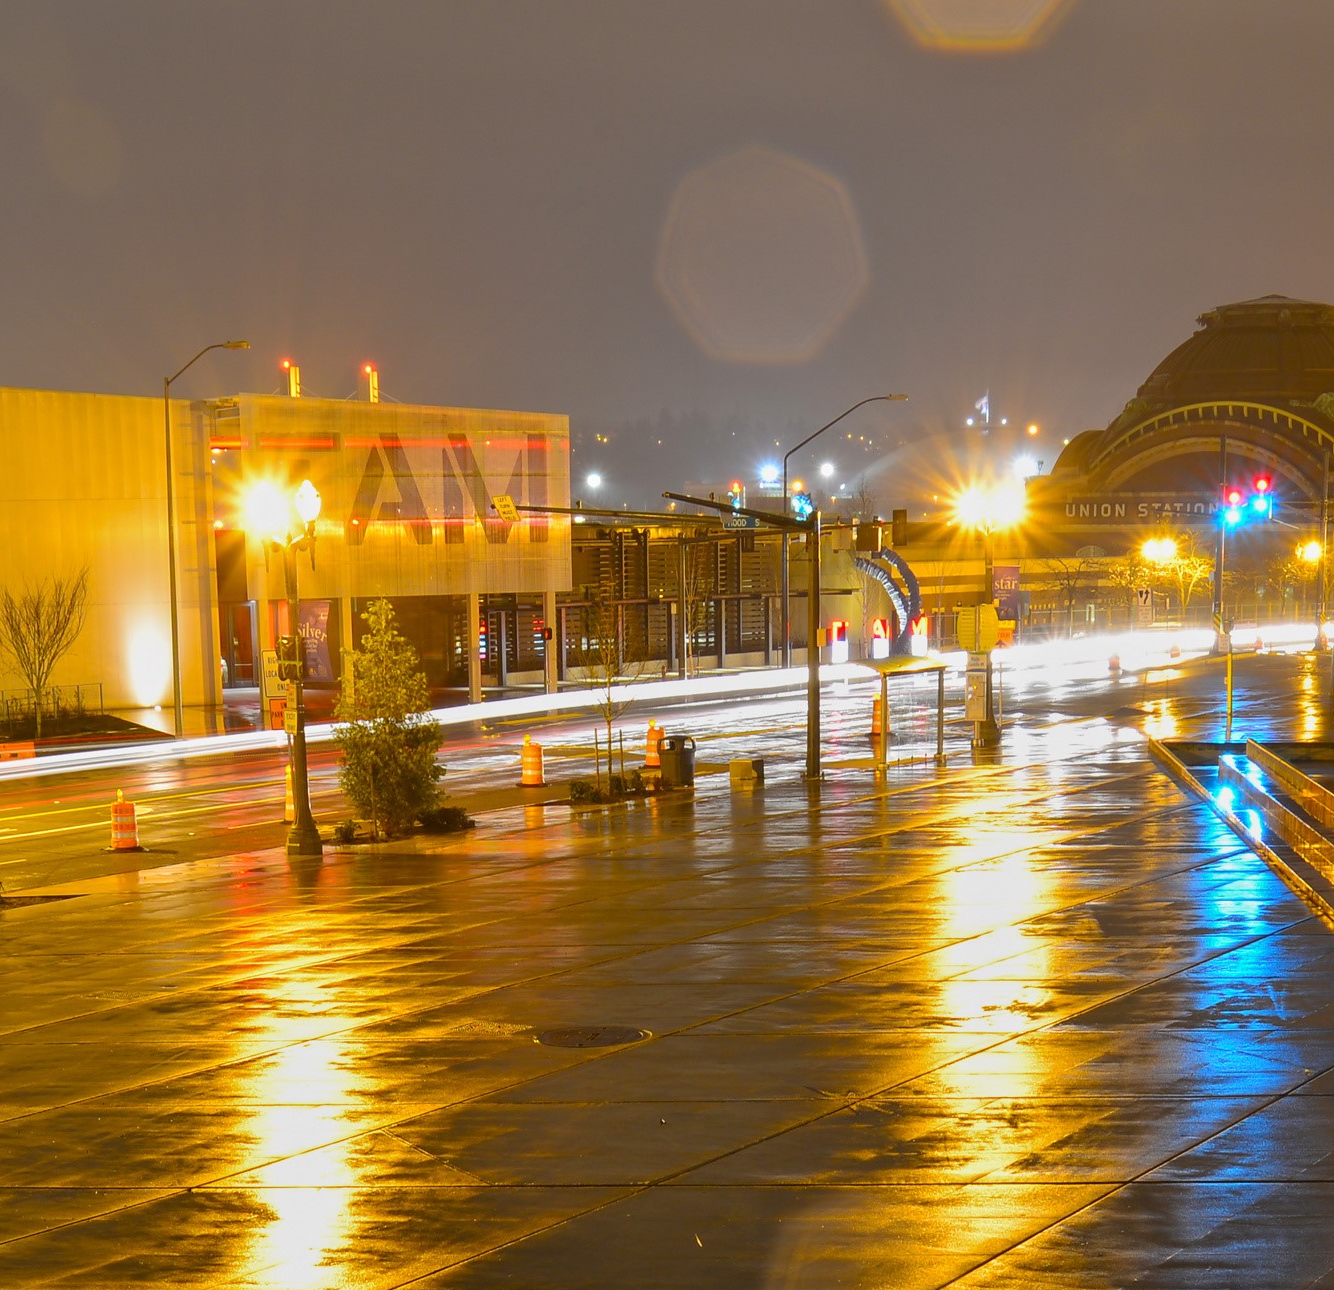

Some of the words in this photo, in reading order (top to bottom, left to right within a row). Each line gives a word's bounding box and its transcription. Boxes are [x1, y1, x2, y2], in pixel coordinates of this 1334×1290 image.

[1065, 503, 1126, 517] UNION
[1137, 502, 1219, 517] STATION
[994, 578, 1018, 590] star
[297, 622, 327, 642] Silver
